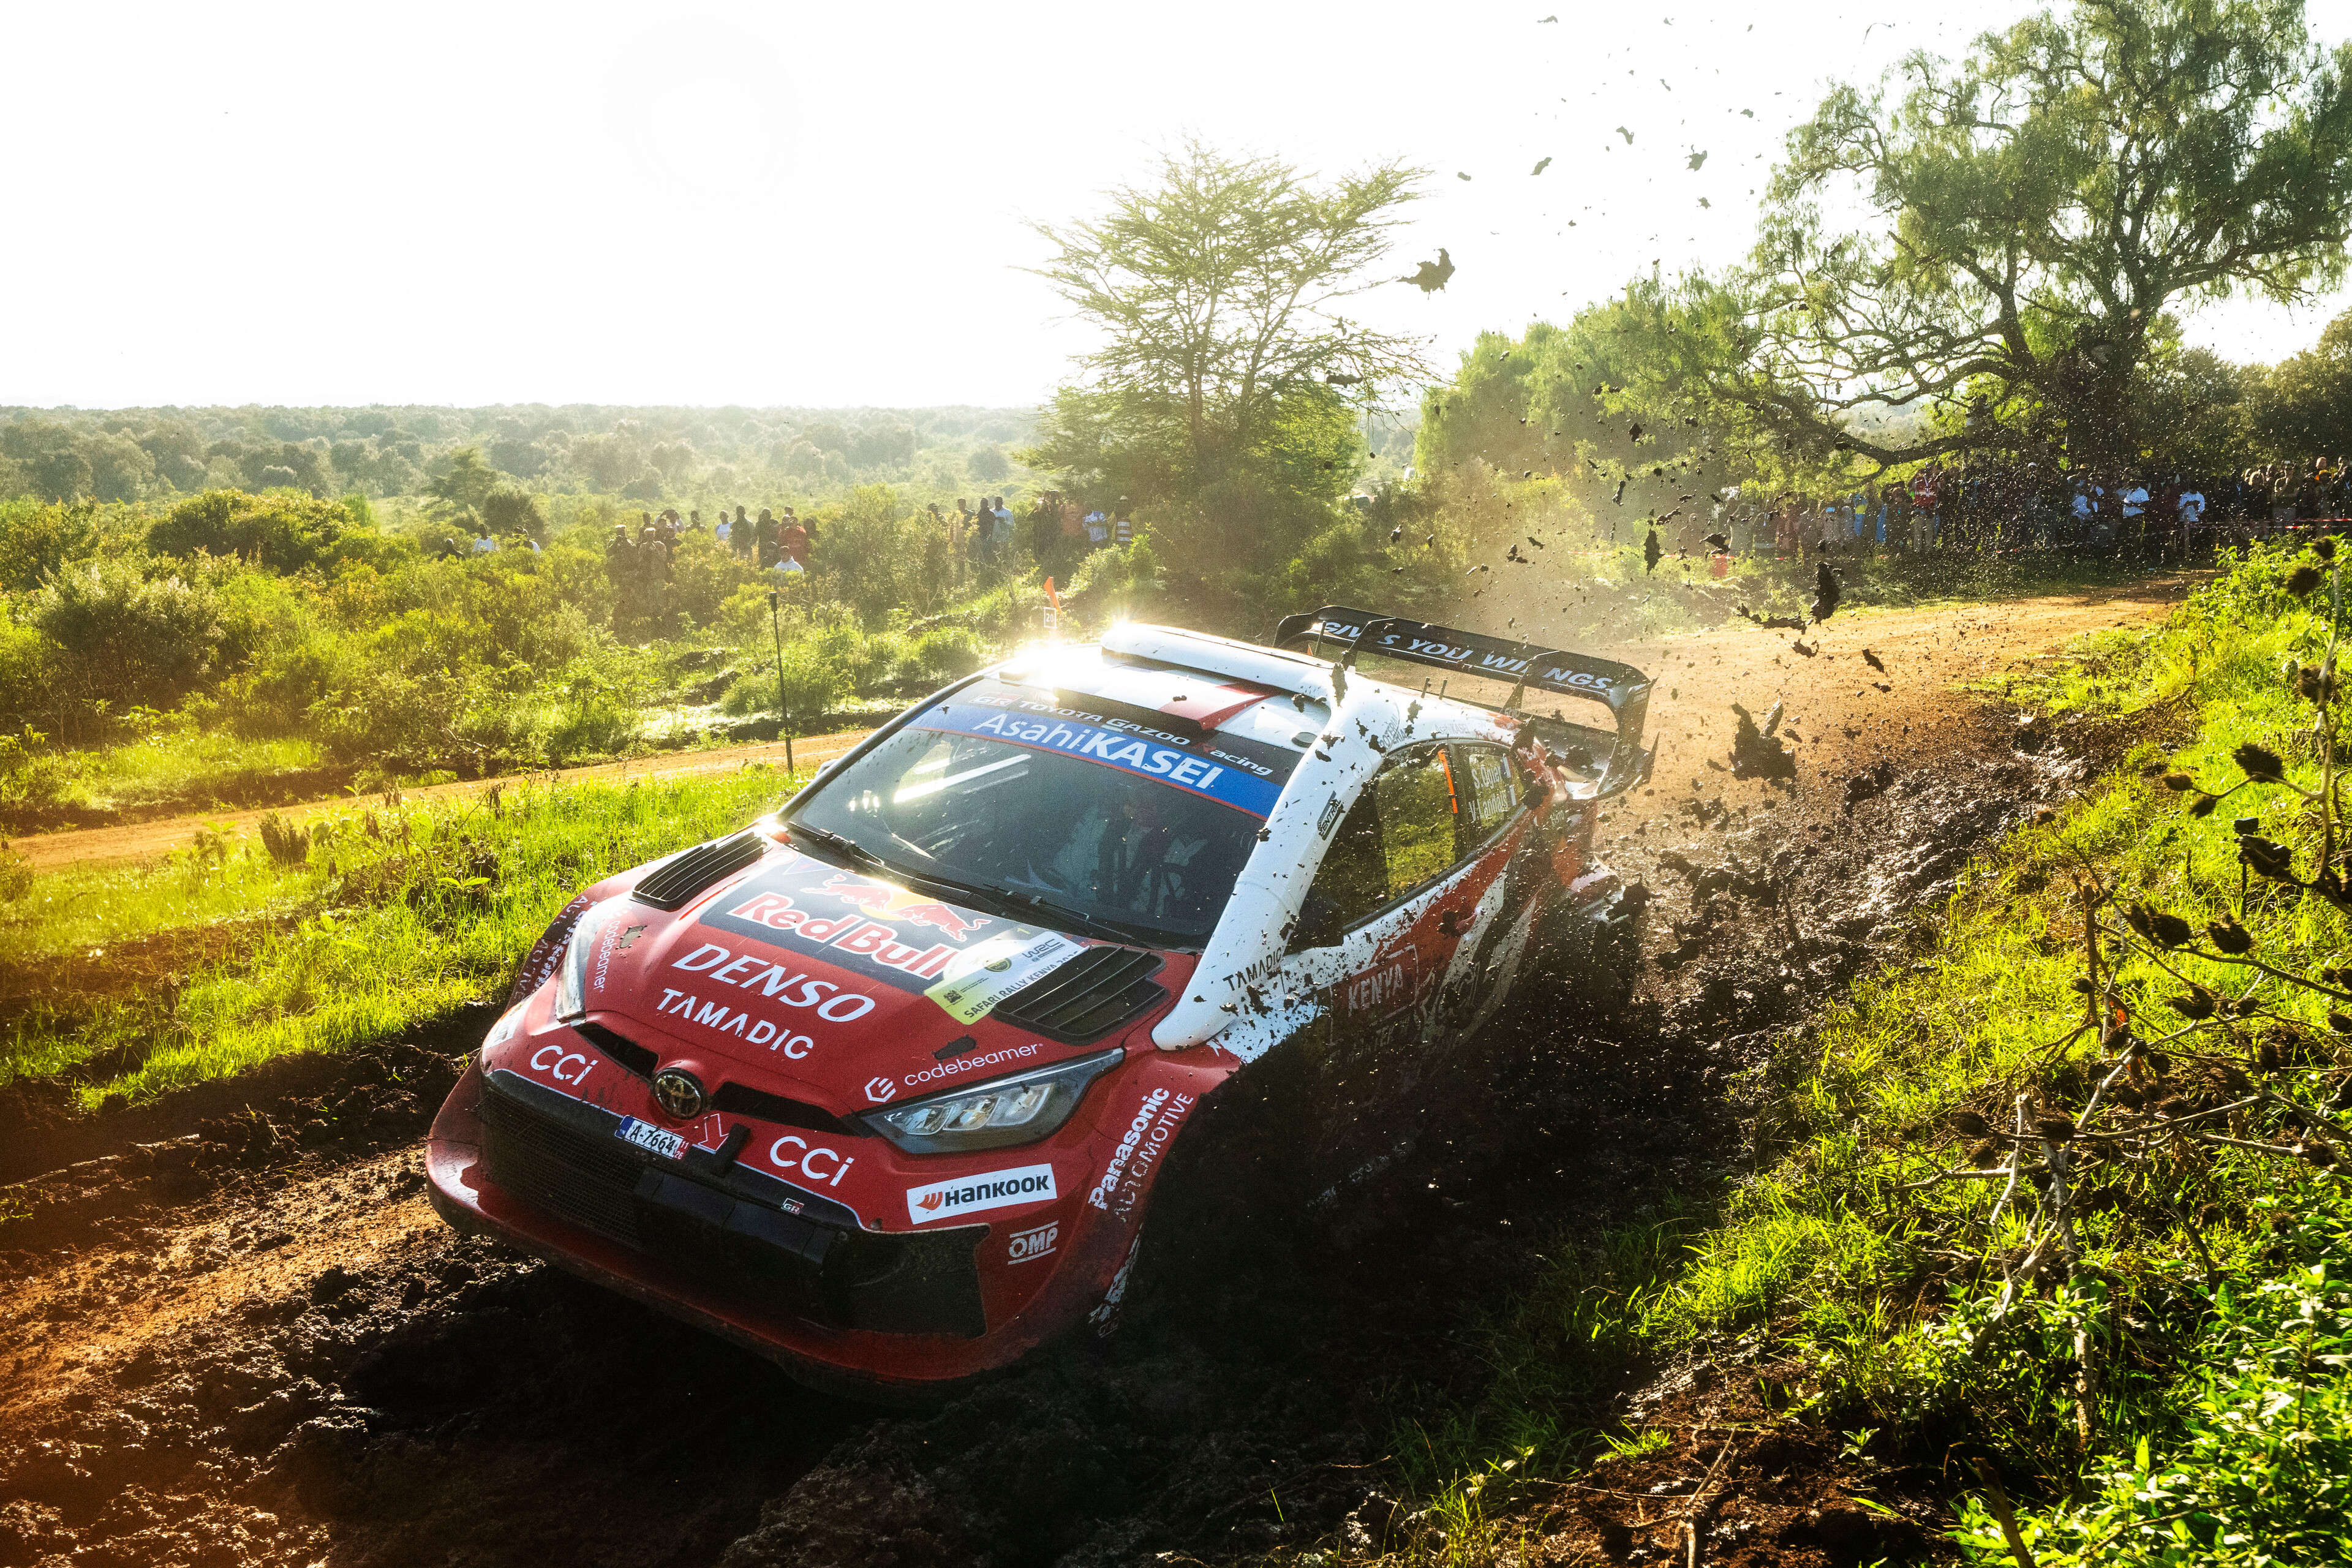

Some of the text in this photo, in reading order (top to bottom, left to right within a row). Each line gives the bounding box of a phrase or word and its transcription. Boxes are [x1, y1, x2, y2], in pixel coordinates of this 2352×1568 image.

[1046, 613, 1054, 623] 20
[1408, 639, 1473, 660] YOU
[1019, 701, 1104, 722] TOYOTA
[1195, 742, 1273, 776] Racing
[593, 921, 621, 990] codebeamer
[1022, 938, 1061, 958] WRC
[1222, 947, 1281, 991] TAMADIC
[671, 943, 876, 1022] DENSO
[964, 994, 1001, 1018] SAFARI
[998, 979, 1028, 997] RALLY
[1348, 963, 1403, 1012] KENYA
[657, 988, 814, 1060] TAMADIC
[904, 1043, 1038, 1086] codebeamer
[1087, 1088, 1170, 1210] Panasonic
[1009, 1227, 1058, 1257] OMP
